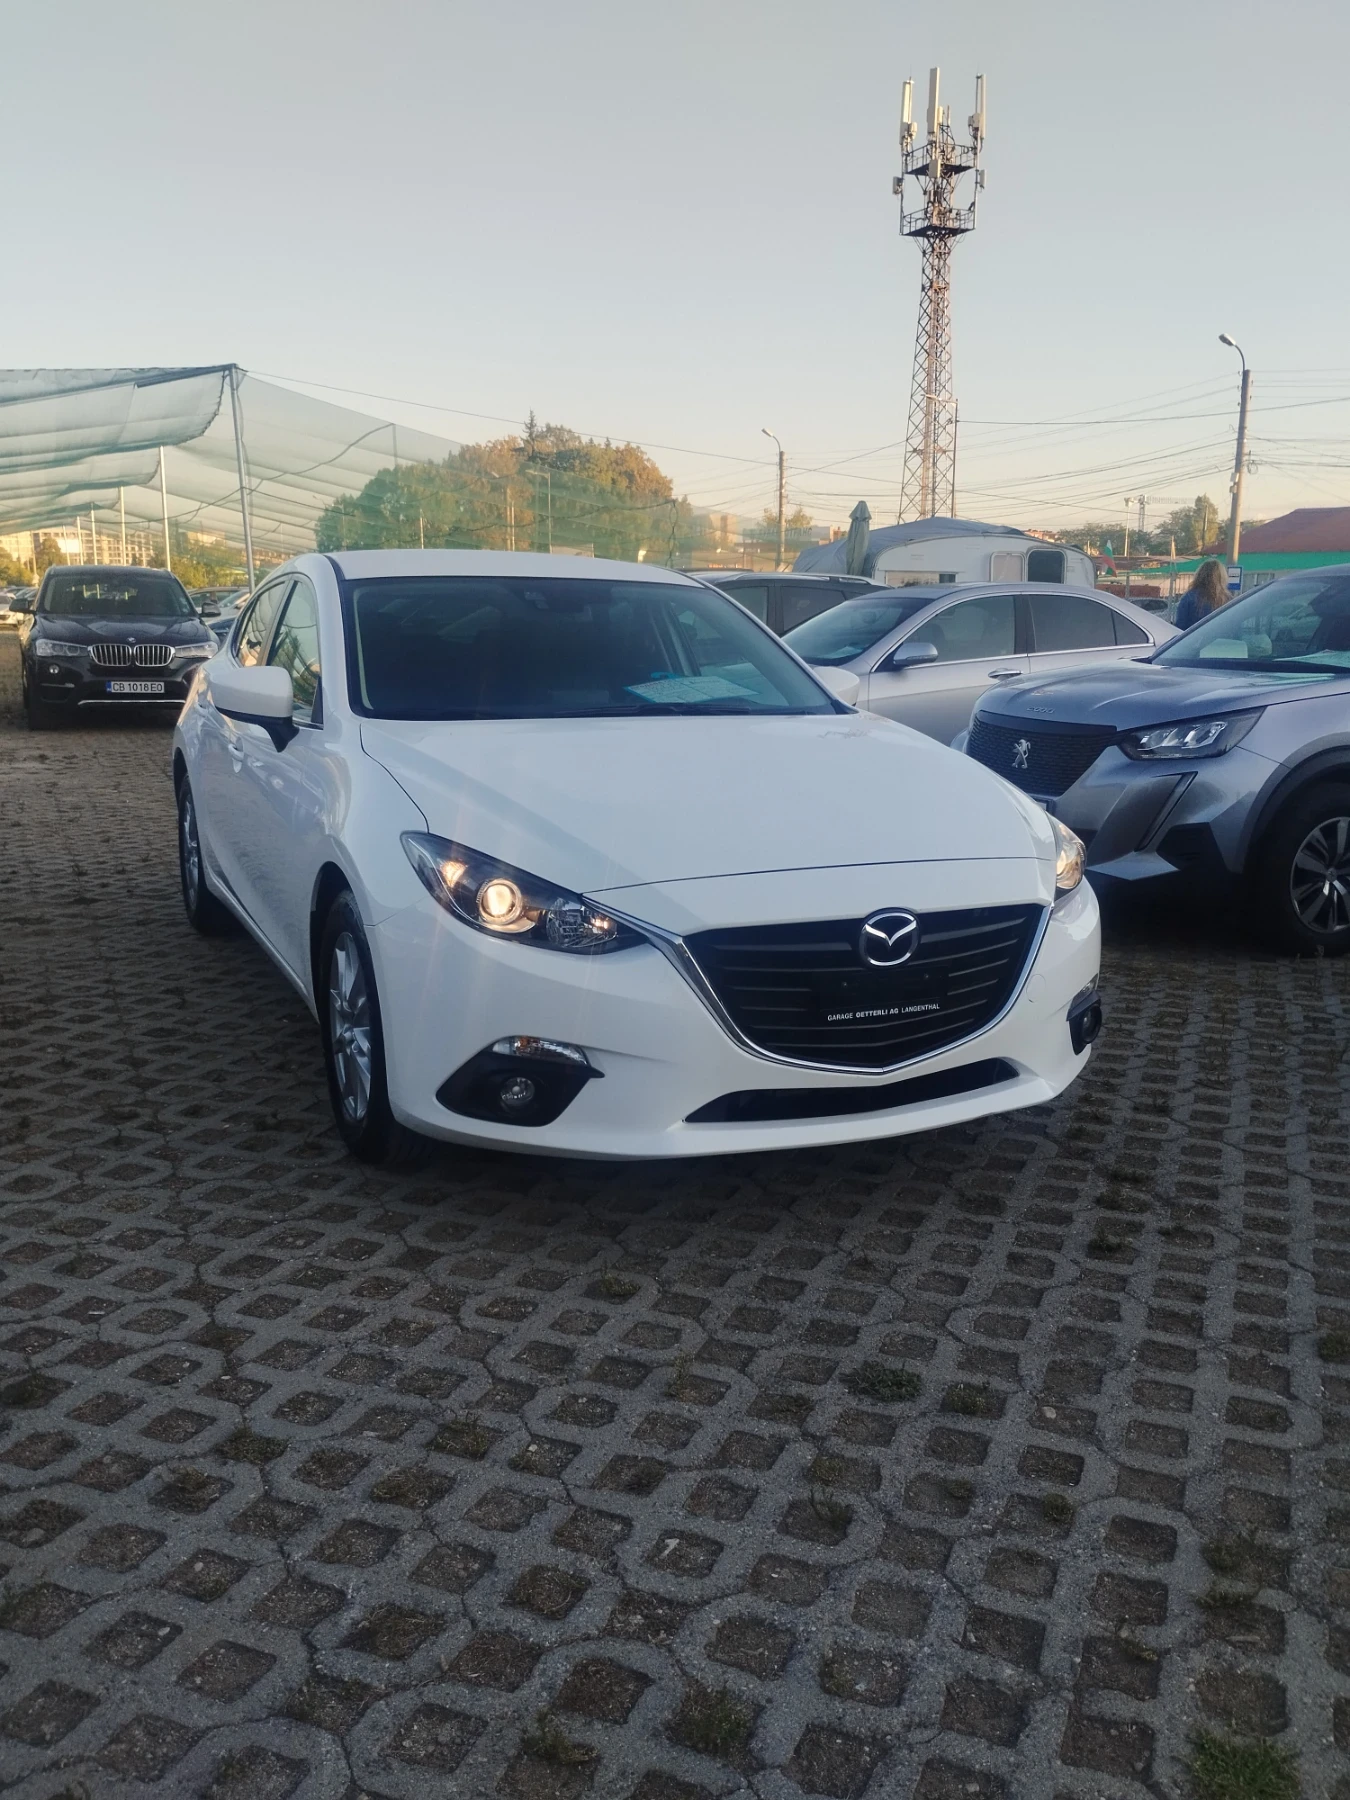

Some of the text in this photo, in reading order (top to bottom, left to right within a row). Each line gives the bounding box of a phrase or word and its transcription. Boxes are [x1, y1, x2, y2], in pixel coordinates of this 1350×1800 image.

[112, 682, 125, 692] CB
[128, 682, 149, 692] 1018
[827, 1012, 854, 1021] GARAGE
[855, 1009, 888, 1018] OETTERLI
[901, 1003, 940, 1014] LANGENTHAL
